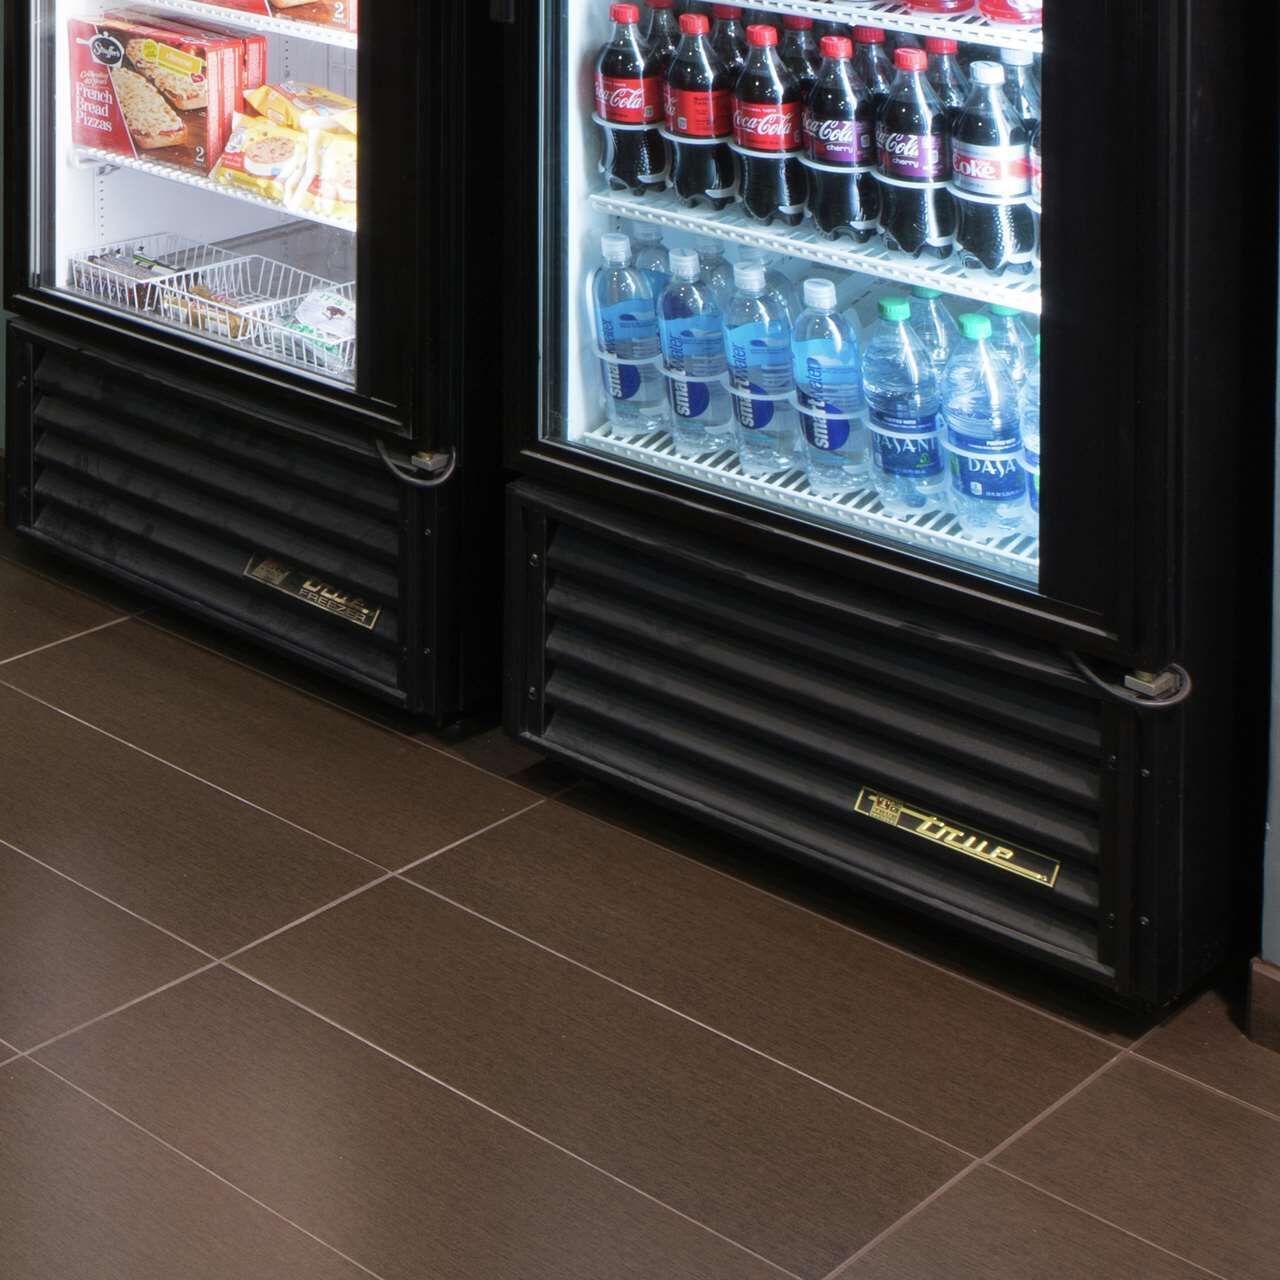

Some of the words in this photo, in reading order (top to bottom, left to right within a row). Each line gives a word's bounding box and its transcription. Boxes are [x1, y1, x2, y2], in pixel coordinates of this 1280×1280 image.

[335, 2, 344, 15] 2
[76, 82, 113, 105] French
[76, 97, 109, 117] Bread
[75, 112, 113, 132] Pizzas
[733, 109, 793, 135] Coca-Cola
[196, 146, 205, 162] 2
[826, 144, 854, 154] cherry
[892, 157, 919, 169] cherry
[953, 153, 997, 179] Coke
[299, 588, 366, 623] FREEZER
